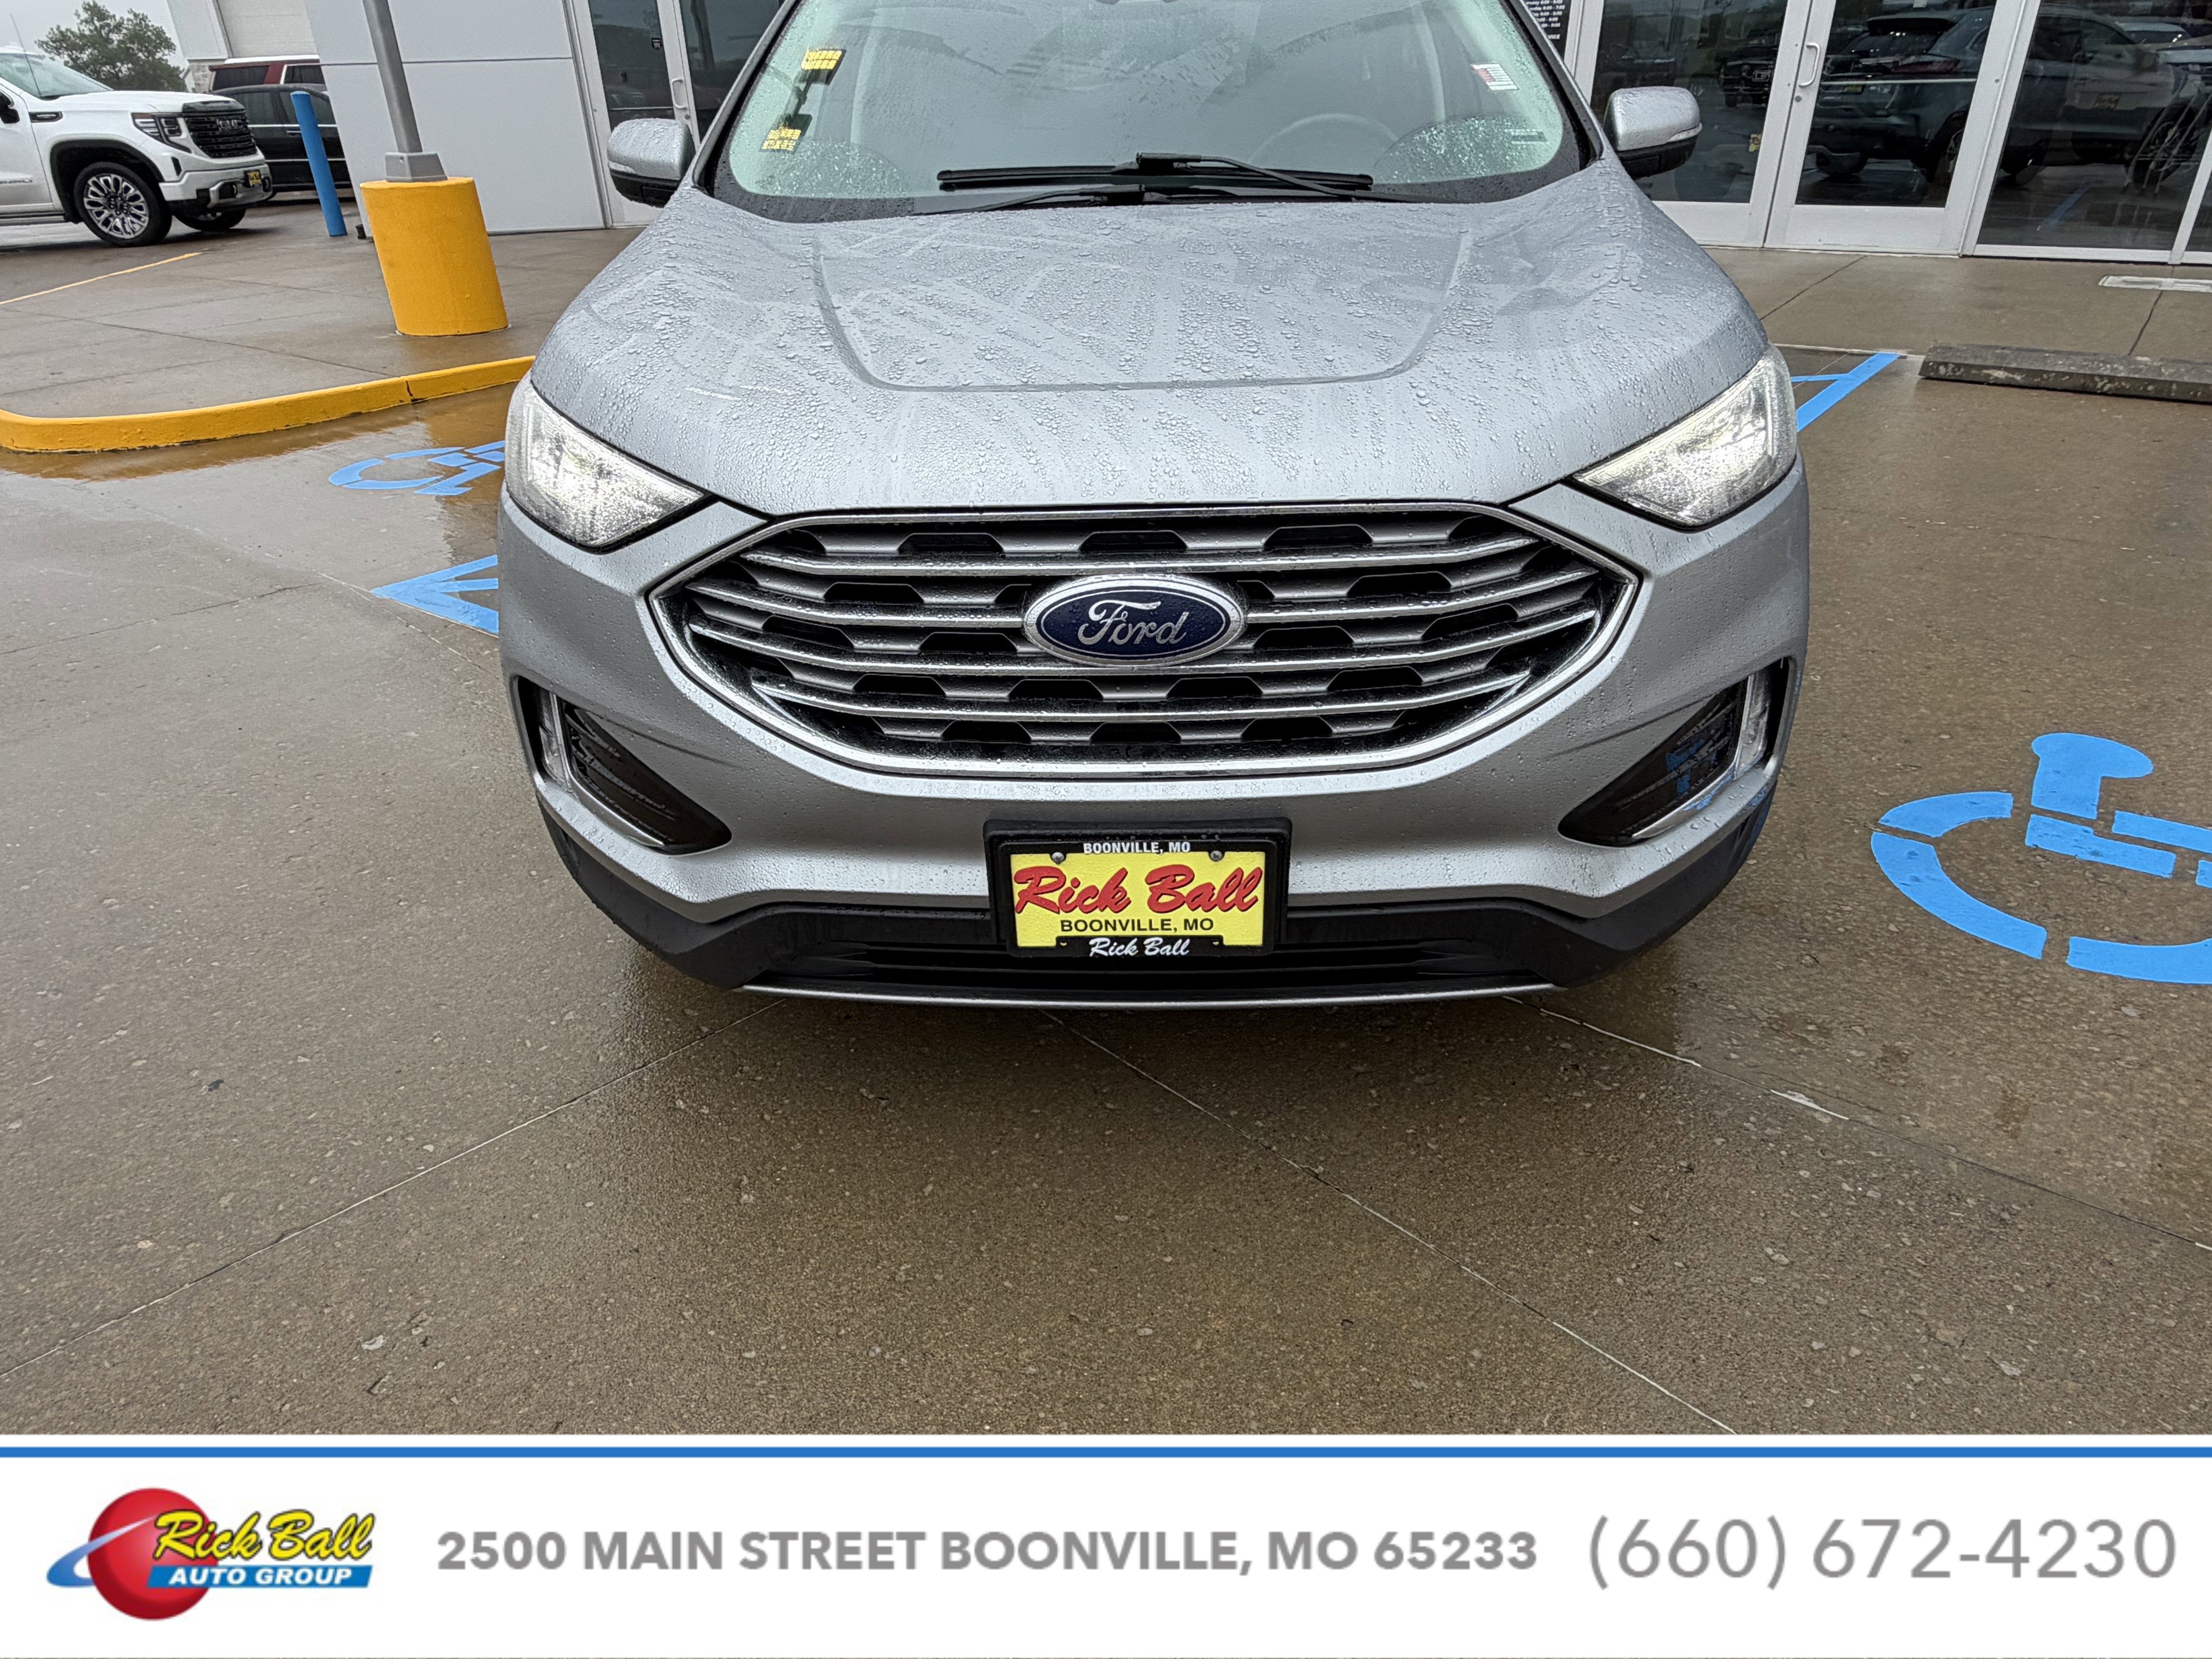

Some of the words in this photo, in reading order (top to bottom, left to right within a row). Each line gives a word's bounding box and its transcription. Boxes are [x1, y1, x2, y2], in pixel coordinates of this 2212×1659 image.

[1078, 599, 1189, 645] Ford
[1084, 842, 1164, 854] BOONVILLE,
[1169, 841, 1190, 853] MO
[1013, 866, 1132, 914] Rick
[1144, 864, 1263, 914] Ball
[1060, 919, 1177, 933] BOONVILLE,
[1183, 918, 1214, 931] MO
[1089, 937, 1139, 957] Rick
[1143, 938, 1190, 956] Ball
